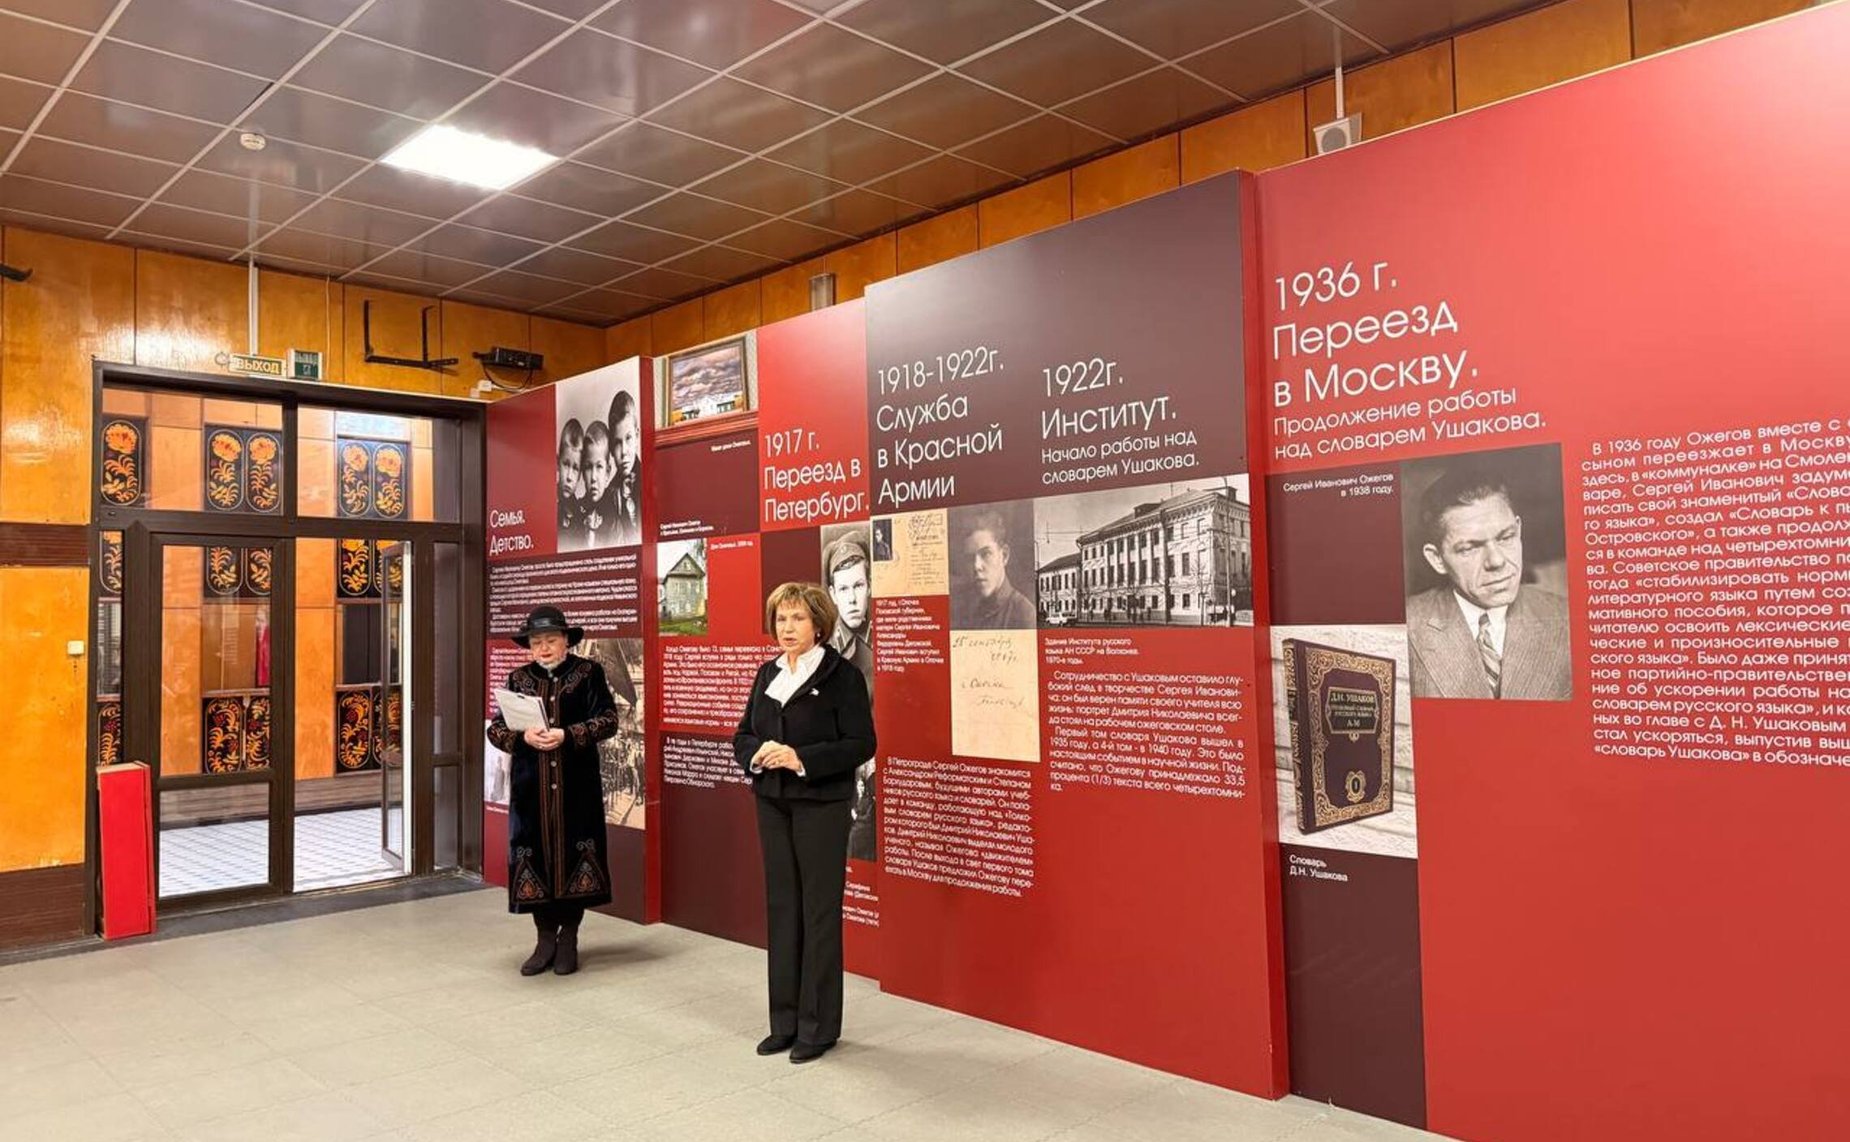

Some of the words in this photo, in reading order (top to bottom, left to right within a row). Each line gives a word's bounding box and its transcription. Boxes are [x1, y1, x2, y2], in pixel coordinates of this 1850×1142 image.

[1275, 262, 1360, 311] 1936
[1374, 262, 1397, 291] г.
[1273, 301, 1458, 360] Переезд
[237, 358, 280, 374] ВЫХОД
[878, 346, 1004, 396] 1918-1922г.
[1043, 357, 1124, 397] 1922г.
[1274, 381, 1291, 407] в
[1304, 350, 1478, 402] Москву.
[876, 394, 968, 433] Служба
[1042, 396, 1177, 440] Институт.
[1274, 400, 1421, 437] Продолжение
[1428, 388, 1516, 417] работы
[766, 428, 802, 458] 1917
[808, 432, 820, 450] г.
[878, 448, 888, 468] в
[894, 422, 1003, 470] Красной
[1274, 444, 1312, 460] над
[1317, 426, 1426, 454] словарем
[1432, 412, 1546, 439] Ушакова.
[1592, 442, 1601, 455] В
[1609, 440, 1641, 453] 1936
[1647, 436, 1681, 450] году
[1687, 429, 1751, 445] Ожегов
[1758, 421, 1821, 438] вместе
[1828, 419, 1840, 431] с
[1042, 445, 1097, 464] Начало
[1101, 436, 1160, 459] работы
[1164, 431, 1197, 447] над
[1581, 457, 1635, 471] сыном
[1643, 444, 1754, 466] переезжает
[1762, 443, 1771, 453] в
[764, 461, 846, 492] Переезд
[851, 458, 861, 477] в
[1042, 464, 1118, 485] словарем
[1121, 452, 1200, 475] Ушакова.
[1582, 473, 1629, 487] здесь,
[1631, 471, 1639, 482] в
[1642, 461, 1756, 480] «коммуналке»
[1759, 458, 1782, 470] на
[1785, 452, 1850, 468] Смоле
[878, 475, 956, 508] Армии
[1583, 488, 1626, 501] варе,
[1632, 479, 1693, 497] Сергей
[1701, 475, 1783, 491] Иванович
[1792, 469, 1850, 484] задум
[765, 491, 870, 523] Петербург.
[1583, 503, 1634, 515] писать
[1637, 496, 1676, 511] свой
[1681, 488, 1781, 508] знаменитый
[490, 509, 525, 529] Семья.
[1584, 520, 1600, 530] го
[1605, 516, 1659, 529] языка»,
[1664, 511, 1723, 525] создал
[1729, 506, 1813, 520] «Словарь
[1820, 504, 1829, 515] к
[489, 535, 534, 555] Детство.
[1585, 529, 1699, 546] Островского»,
[1704, 528, 1716, 538] а
[1720, 524, 1771, 537] также
[1585, 549, 1603, 560] ся
[1606, 549, 1614, 559] в
[1617, 545, 1687, 558] команде
[1691, 544, 1722, 555] над
[1586, 565, 1608, 575] ва.
[1612, 560, 1700, 573] Советское
[1704, 554, 1830, 572] правительство
[1587, 578, 1628, 590] тогда
[1636, 572, 1789, 588] «стабилизировать
[1797, 570, 1850, 584] норм
[1587, 591, 1703, 606] литературного
[1710, 590, 1757, 601] языка
[1764, 588, 1815, 602] путем
[1588, 608, 1668, 619] мативного
[1674, 604, 1750, 618] пособия,
[1757, 604, 1833, 618] которое
[1589, 623, 1659, 633] читателю
[1664, 622, 1730, 633] освоить
[1735, 620, 1850, 632] лексические
[1590, 638, 1646, 648] ческие
[1654, 639, 1664, 648] и
[1671, 637, 1839, 651] произносительные
[1590, 653, 1634, 664] ского
[1637, 654, 1692, 664] языка».
[1697, 651, 1737, 664] Было
[1741, 654, 1789, 666] даже
[1053, 670, 1124, 682] Сотрудничество
[1131, 672, 1178, 683] Ушаковым
[1179, 675, 1224, 684] оставило
[1591, 669, 1621, 679] ное
[1628, 667, 1850, 682] партийно-правительстве
[1592, 684, 1620, 694] ние
[1626, 682, 1647, 694] об
[1654, 685, 1745, 698] ускорении
[1753, 684, 1820, 699] работы
[1592, 699, 1671, 712] словарем
[1674, 700, 1753, 713] русского
[1756, 702, 1819, 715] языка»,
[1822, 704, 1833, 715] и
[1593, 714, 1619, 724] ных
[1624, 715, 1642, 725] во
[1646, 716, 1689, 726] главе
[1694, 717, 1704, 727] с
[1709, 715, 1726, 730] Д.
[1731, 715, 1747, 728] Н.
[1753, 716, 1846, 732] Ушаковым
[1055, 726, 1088, 739] Первый
[1091, 730, 1107, 738] том
[1110, 731, 1149, 742] словаря
[1152, 732, 1197, 744] Ушакова
[1201, 737, 1233, 747] вышел
[1237, 739, 1243, 748] в
[1593, 729, 1627, 739] стал
[1633, 730, 1728, 745] ускоряться,
[1735, 734, 1811, 748] выпустив
[1092, 741, 1099, 749] а
[1100, 740, 1114, 750] 4-й
[1116, 743, 1132, 751] том
[1140, 745, 1145, 753] в
[1148, 743, 1169, 755] 1940
[1197, 747, 1216, 758] Это
[1218, 748, 1244, 760] было
[1594, 744, 1666, 759] «словарь
[1668, 745, 1749, 761] Ушакова»
[1752, 751, 1761, 762] в
[1289, 854, 1328, 869] Словарь
[1309, 867, 1348, 882] Ушакова
